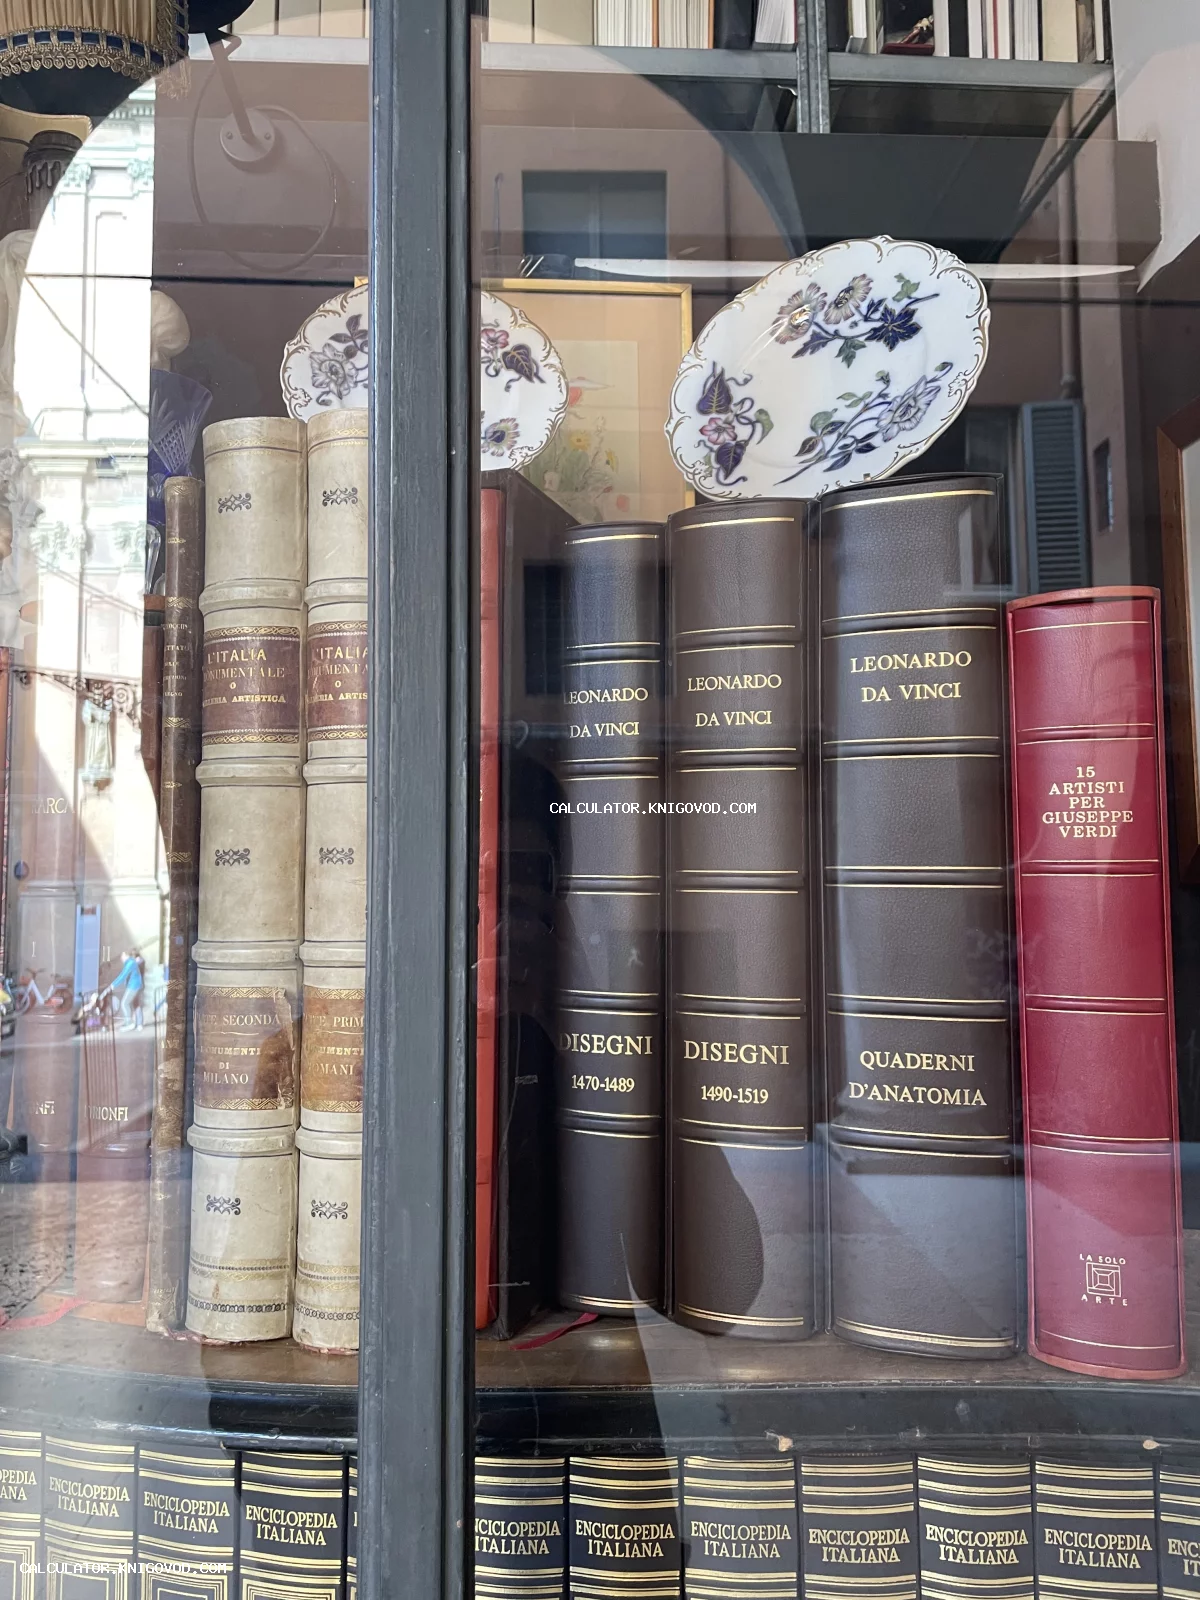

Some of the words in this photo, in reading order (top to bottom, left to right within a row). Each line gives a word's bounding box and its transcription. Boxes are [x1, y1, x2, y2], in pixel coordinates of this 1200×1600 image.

[207, 648, 267, 665] L'ITALIA
[314, 646, 368, 660] 'ITALIA
[850, 650, 972, 673] LEONARDO
[229, 682, 237, 690] O
[335, 680, 342, 688] O
[687, 674, 782, 692] LEONARDO
[861, 685, 892, 702] DA
[898, 682, 962, 700] VINCI
[231, 693, 286, 703] ARTISTICA
[564, 687, 649, 705] LEONARDO
[695, 712, 721, 728] DA
[722, 710, 773, 726] VINCI
[569, 724, 592, 739] DA
[594, 721, 640, 737] VINCI
[1076, 766, 1096, 779] 15
[1048, 781, 1126, 796] ARTISTI
[1068, 796, 1105, 809] PER
[1042, 809, 1134, 824] GIUSEPPE
[1058, 824, 1118, 838] VERDI
[222, 1014, 281, 1026] SECONDA
[560, 1033, 653, 1055] DISEGNI
[683, 1039, 790, 1065] DISEGNI
[218, 1061, 230, 1070] DI
[859, 1050, 975, 1072] QUADERNI
[203, 1071, 249, 1085] MILANO
[571, 1074, 635, 1093] 1470-1489
[700, 1085, 769, 1104] 1490-1519
[848, 1081, 988, 1106] D'ANATOMIA
[1081, 1293, 1128, 1307] ARTE
[0, 1469, 37, 1485] PEDIA
[49, 1476, 131, 1502] ENCICLOPEDIA
[57, 1495, 120, 1518] ITALIANA
[143, 1491, 231, 1517] ENCICLOPEDIA
[153, 1510, 219, 1534] ITALIANA
[245, 1504, 338, 1529] ENCICLOPEDIA
[256, 1523, 327, 1546] ITALIANA
[575, 1519, 675, 1540] ENCICLOPEDIA
[690, 1520, 792, 1540] ENCICLOPEDIA
[808, 1528, 910, 1546] ENCICLOPEDIA
[925, 1523, 1029, 1547] ENCICLOPEDIA
[475, 1537, 550, 1556] ITALIANA
[587, 1539, 664, 1558] ITALIANA
[1044, 1528, 1153, 1551] ENCICLOPEDIA
[1168, 1538, 1200, 1558] ENC
[703, 1540, 781, 1559] ITALIANA
[821, 1546, 901, 1563] ITALIANA
[938, 1544, 1020, 1565] ITALIANA
[1058, 1550, 1142, 1569] ITALIANA
